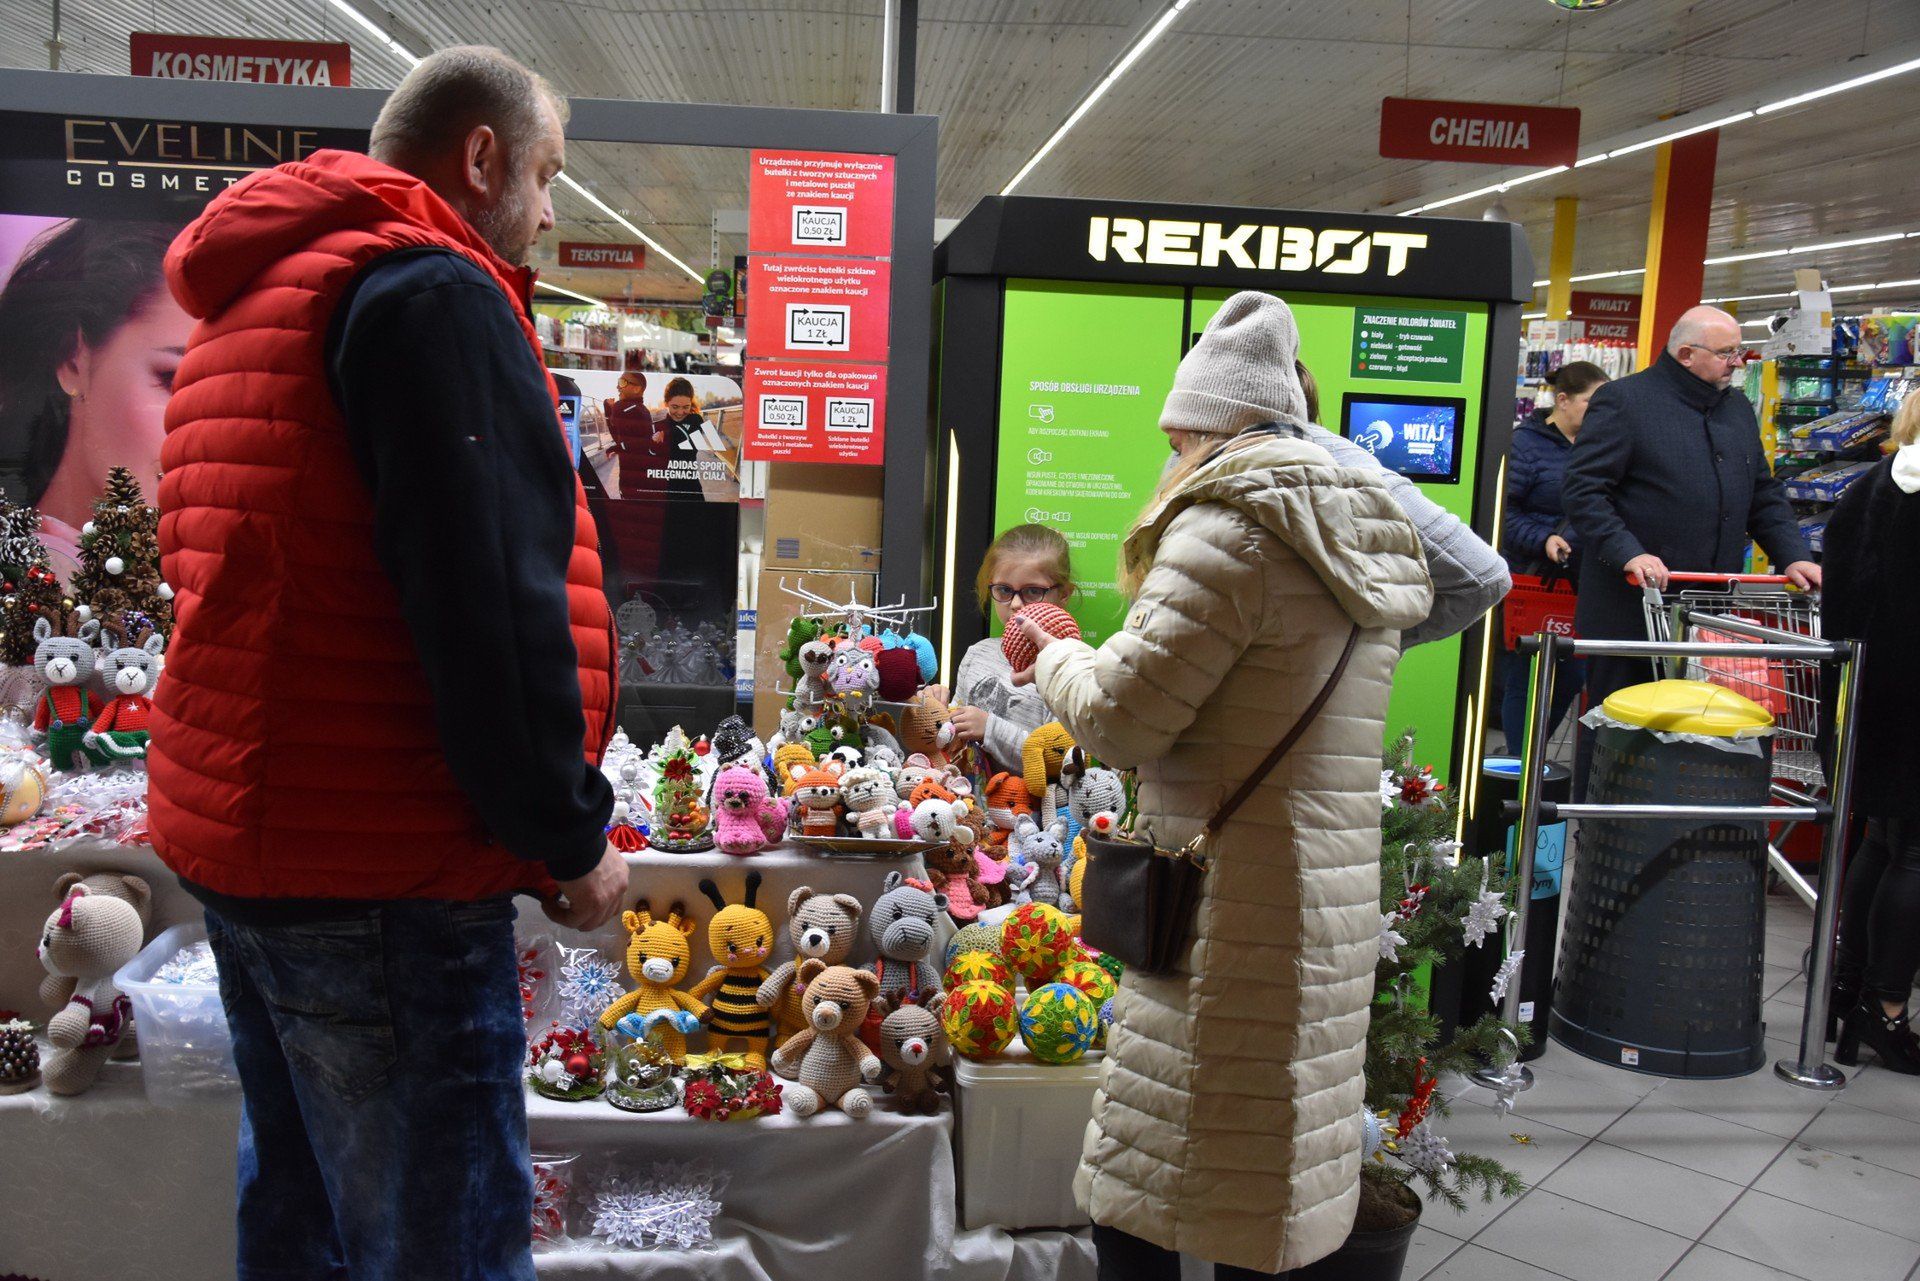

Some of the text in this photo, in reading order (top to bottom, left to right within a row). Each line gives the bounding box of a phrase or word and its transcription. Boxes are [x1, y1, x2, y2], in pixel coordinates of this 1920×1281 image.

[151, 51, 332, 87] KOSMETYKA
[1429, 116, 1529, 149] CHEMIA
[65, 119, 318, 164] EVELINE
[759, 157, 883, 171] Urządzenie przyjmuje wyłącznie
[67, 169, 238, 192] COSMET
[764, 168, 792, 177] butelki
[799, 170, 833, 179] tworzyw
[835, 172, 877, 181] sztucznych
[790, 180, 828, 189] metalowe
[830, 181, 855, 191] puszki
[797, 190, 829, 199] znakiem
[831, 191, 855, 201] kaucji
[802, 217, 836, 225] KAUCJA
[804, 227, 834, 236] 0,50 ZŁ
[1088, 216, 1428, 277] REKBOT
[570, 249, 634, 263] TEKSTYLIA
[763, 264, 876, 275] Tutaj zwrócisz butelki szklane
[777, 275, 861, 286] wielokrotnego użytku
[811, 286, 844, 294] znakiem
[845, 287, 869, 297] kaucji
[1589, 299, 1631, 312] KWIATY
[797, 317, 838, 326] KAUCJA
[1363, 315, 1457, 329] ZNACZENIE KOLORÓW ŚWIATEŁ
[808, 330, 827, 338] 1 ZŁ
[1371, 331, 1384, 340] biały
[1588, 325, 1629, 338] ZNICZE
[754, 367, 878, 381] Zwrot kaucji tylko dla opakowań
[762, 380, 869, 391] oznaczonych znakiem kaucji
[1030, 380, 1140, 396] SPOSÓB OBSŁUGI URZĄDZENIA
[768, 404, 799, 412] KAUCJA
[834, 407, 865, 415] KAUCJA
[1403, 422, 1445, 442] WITAJ
[667, 460, 727, 471] ADIDAS SPORT
[647, 469, 726, 481] PIELĘGNACJA CIAŁA
[1546, 618, 1572, 634] tss
